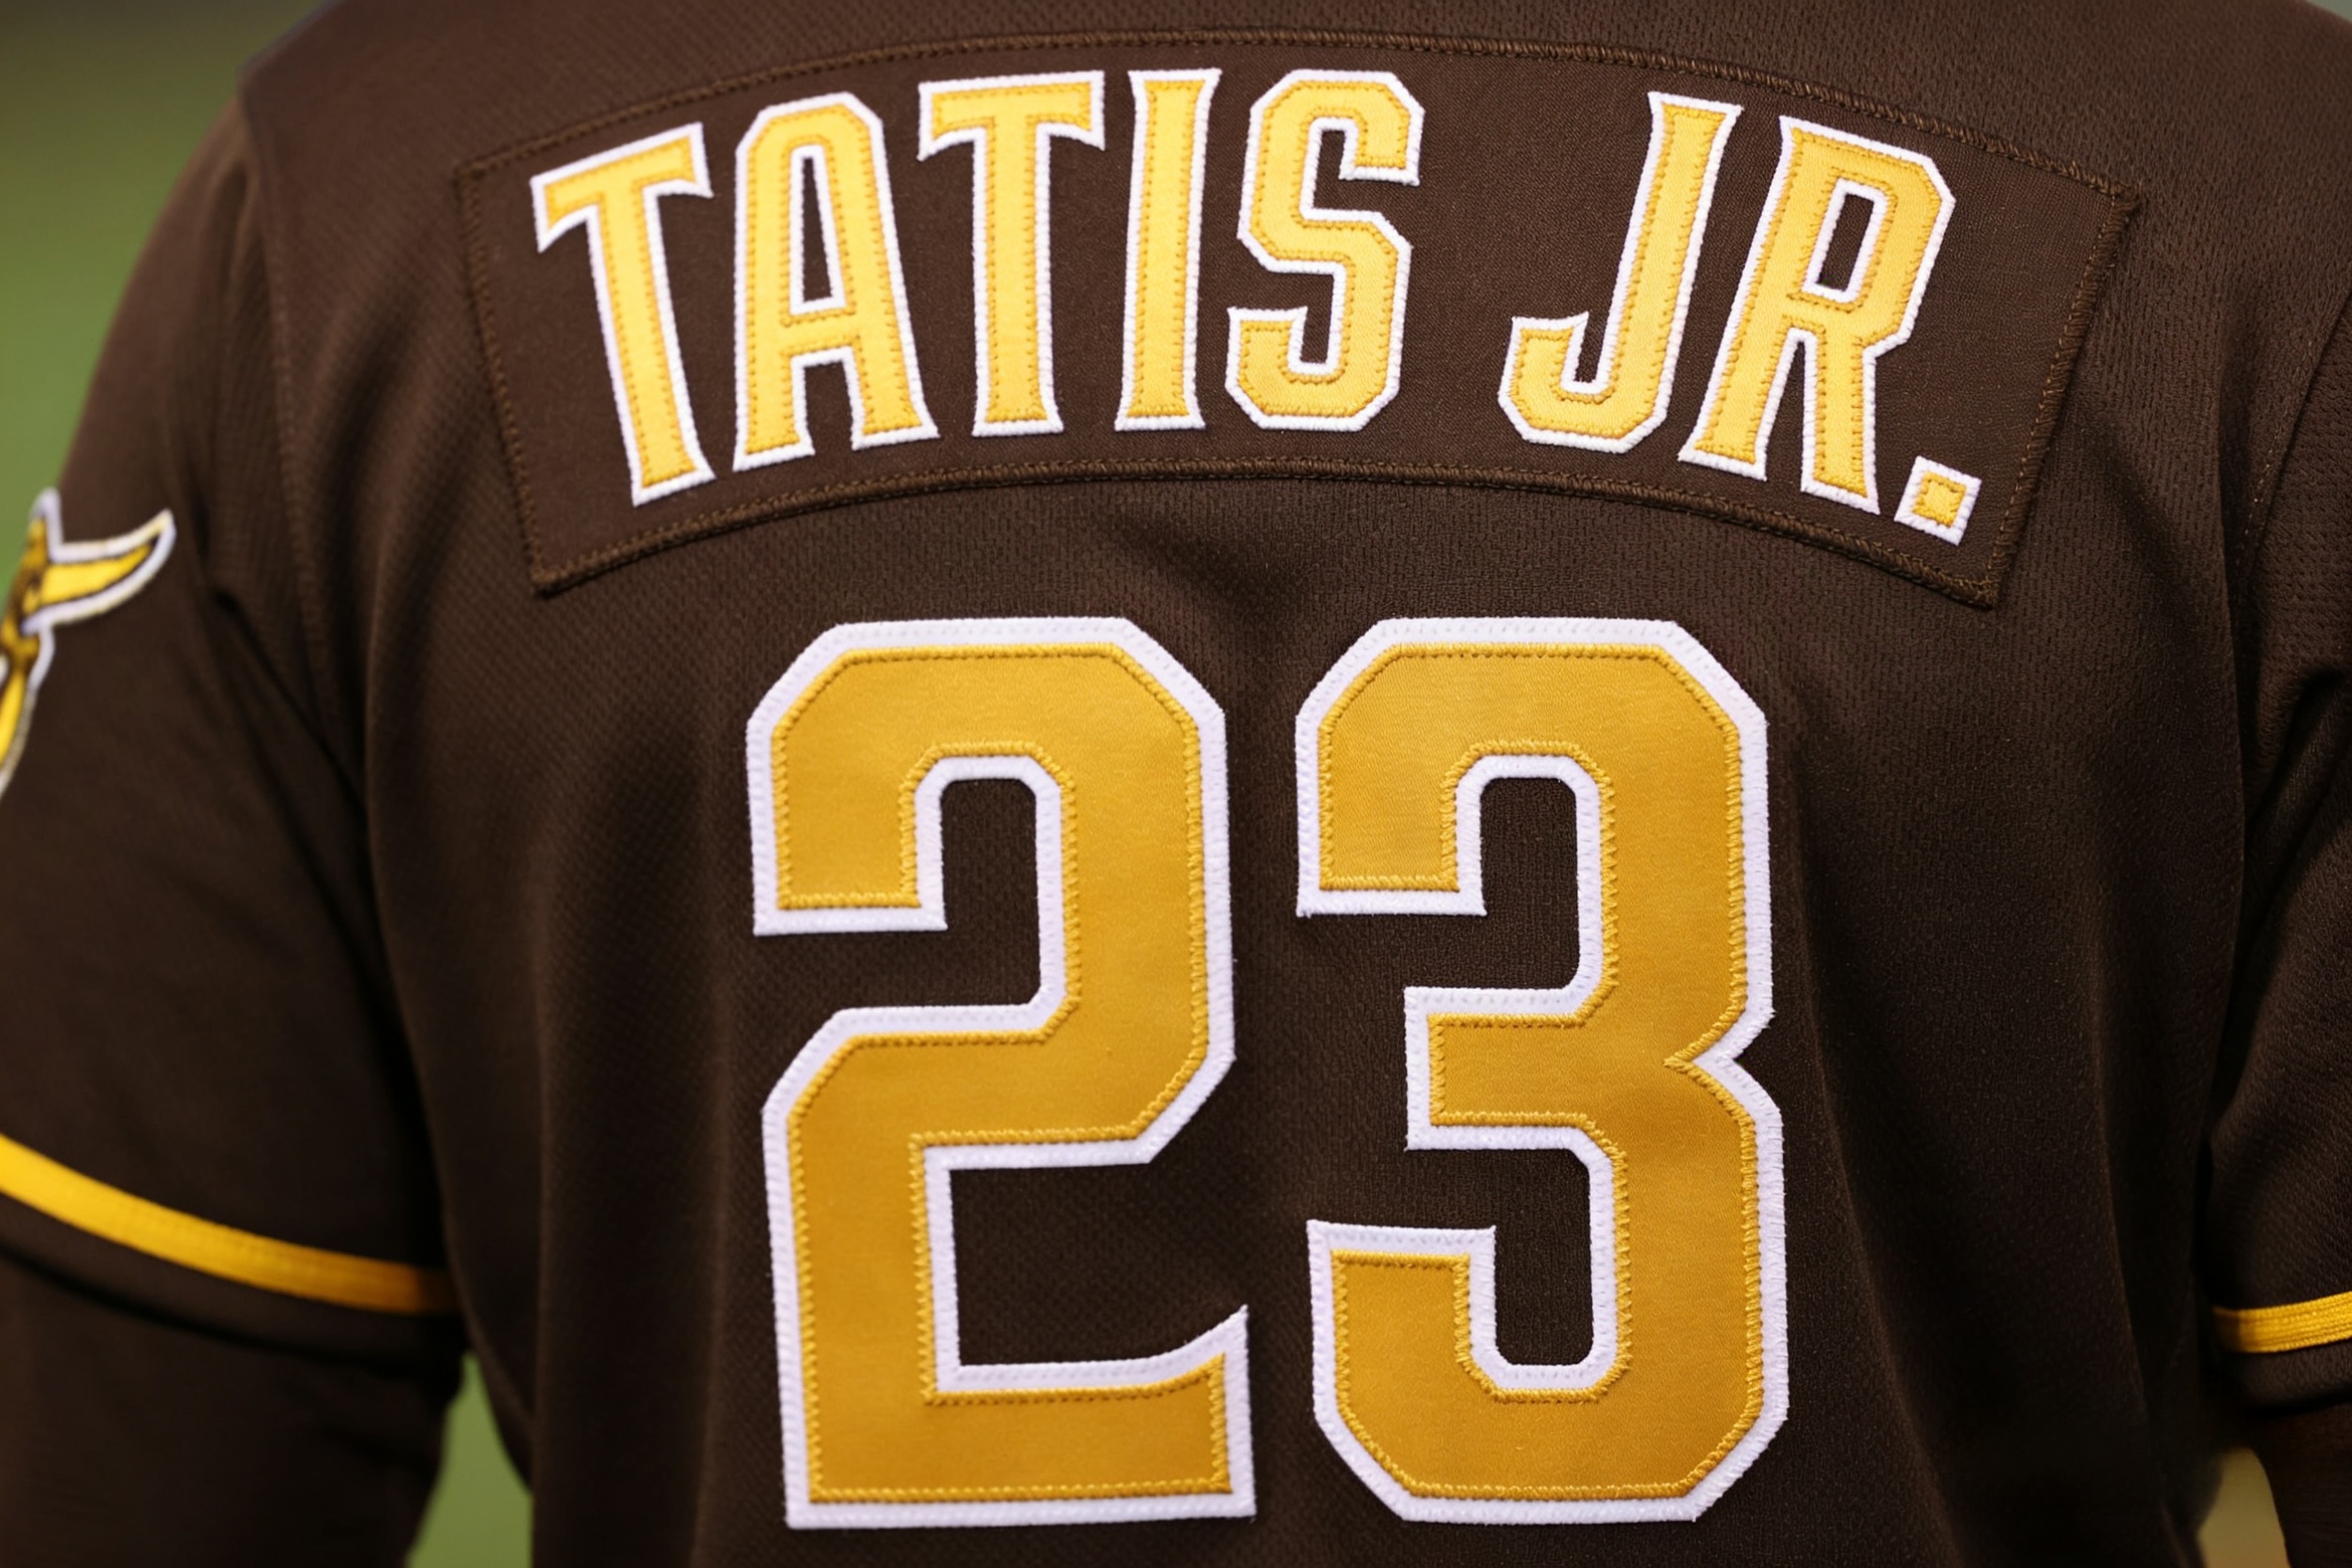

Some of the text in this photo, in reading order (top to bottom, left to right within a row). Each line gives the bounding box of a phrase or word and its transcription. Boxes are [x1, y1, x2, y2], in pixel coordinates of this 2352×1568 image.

[530, 68, 1982, 545] TATIS JR.
[746, 616, 1789, 1528] 23
